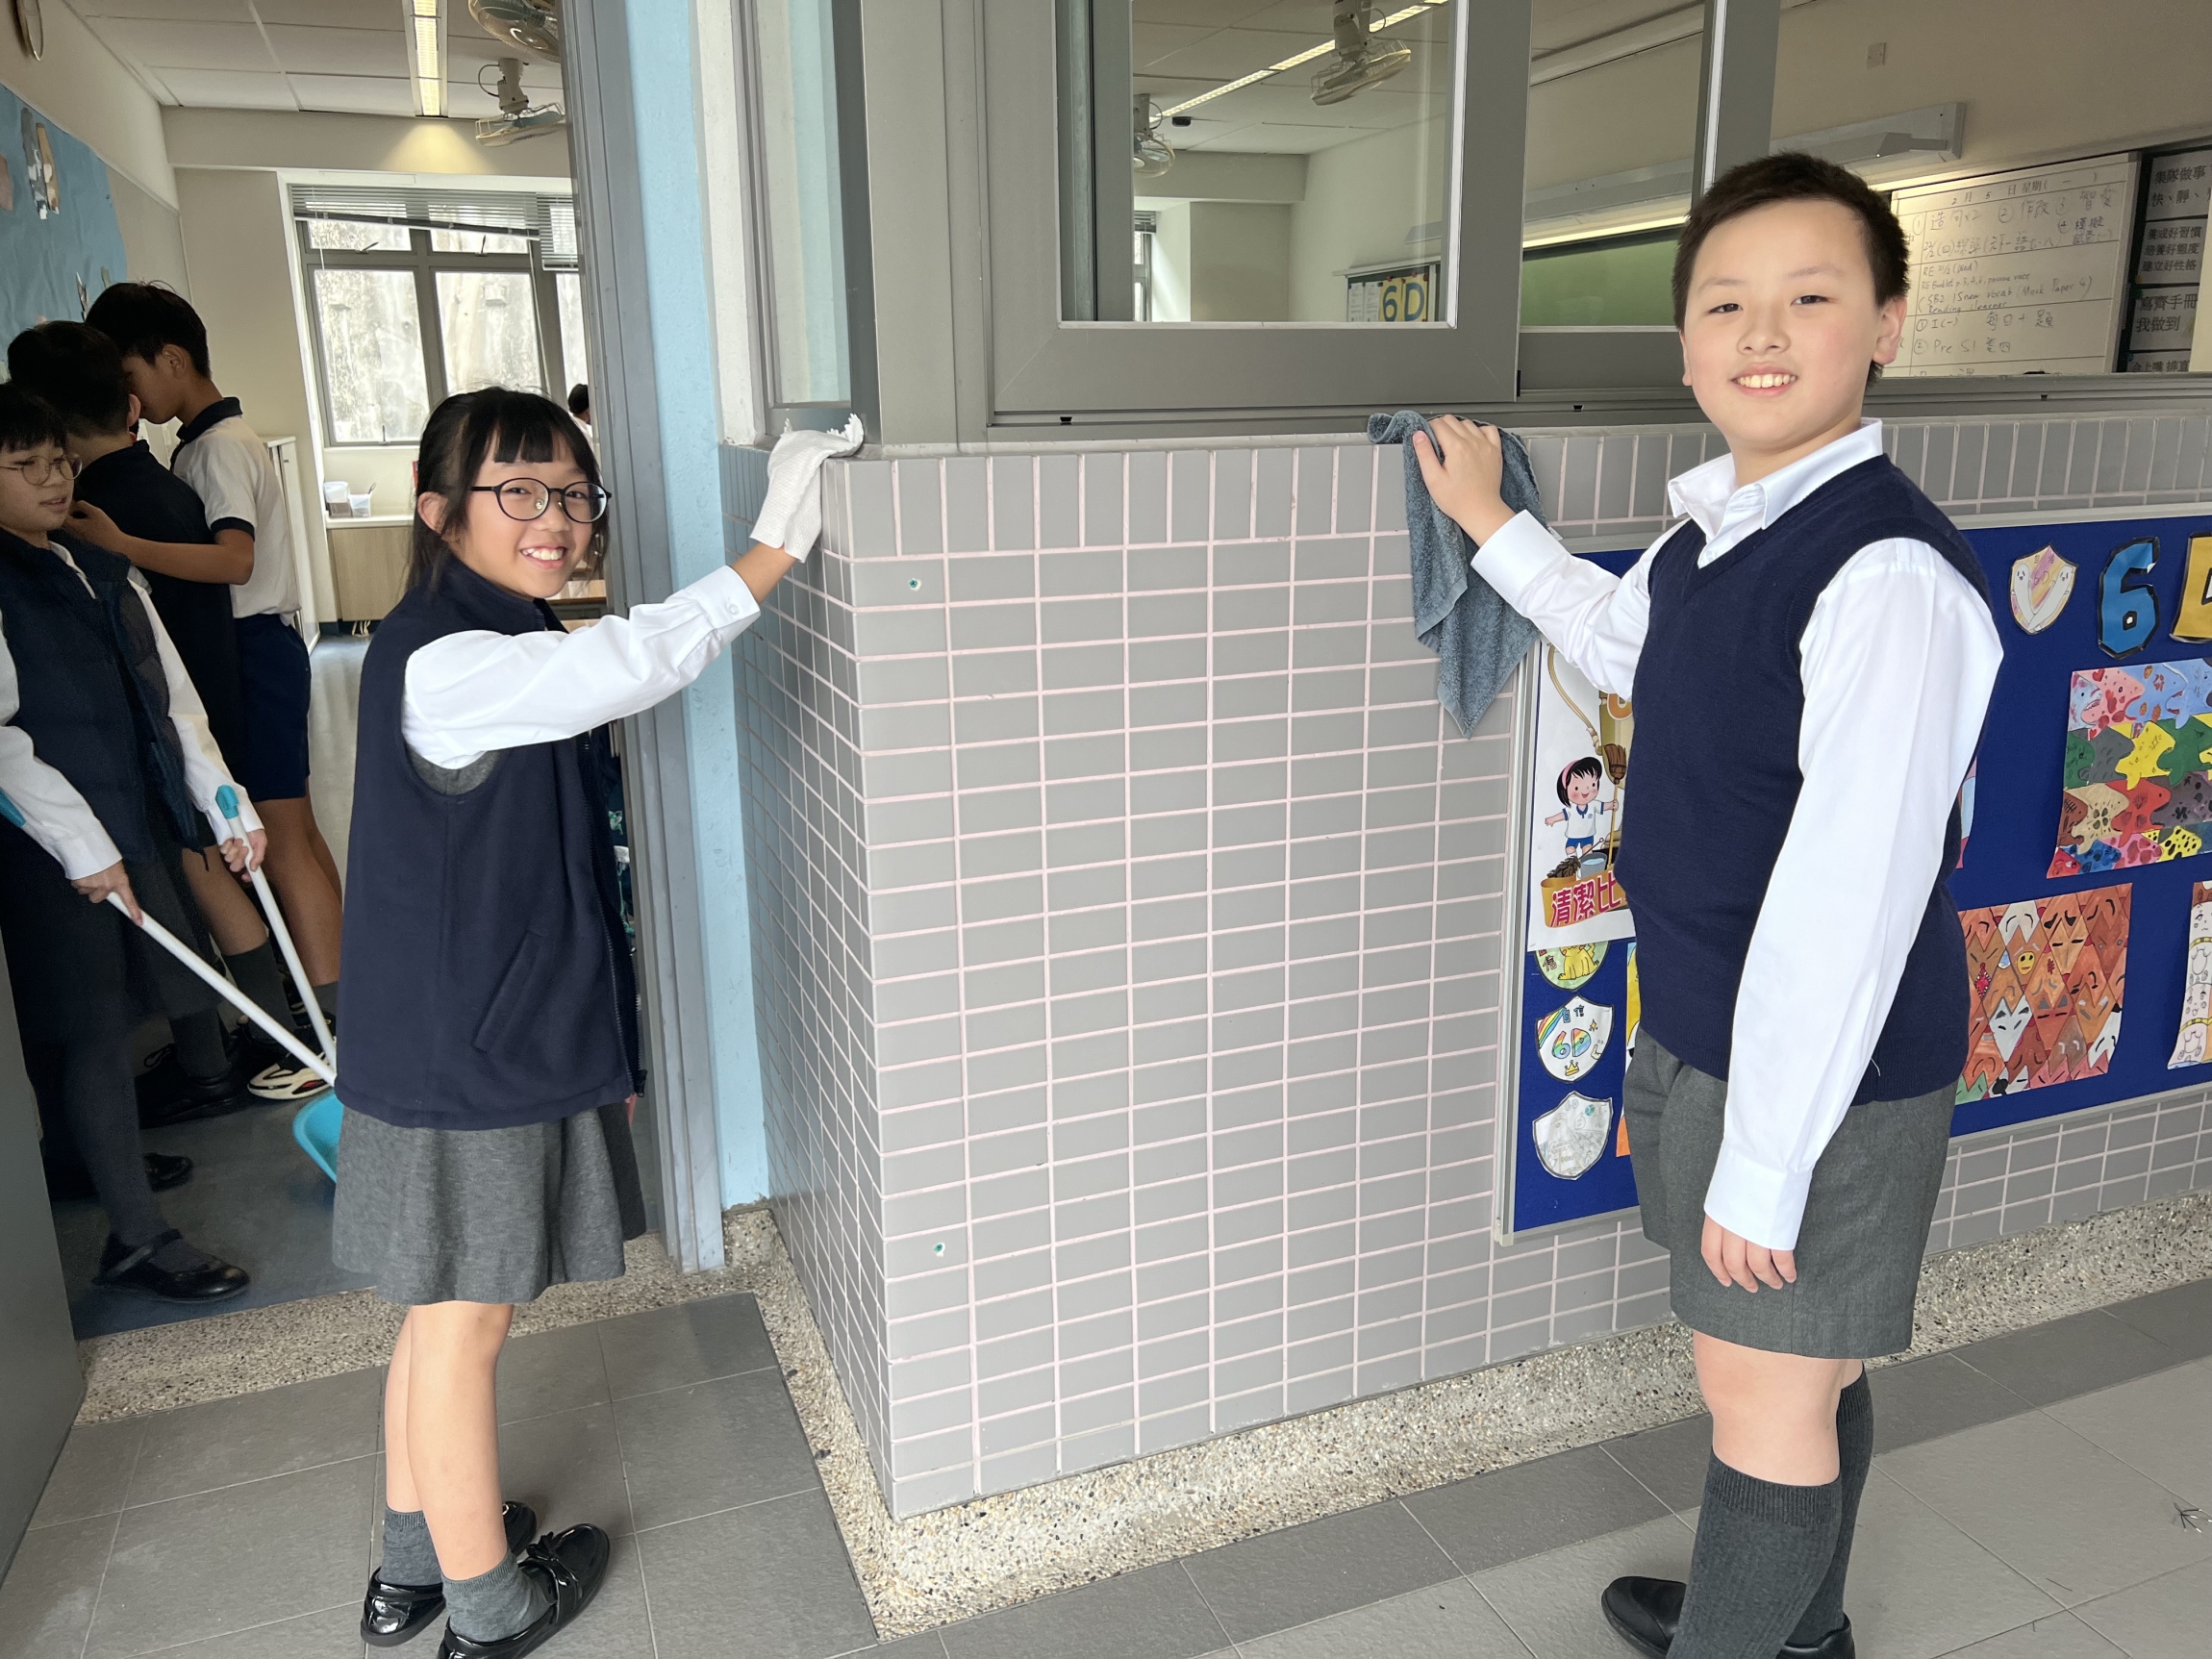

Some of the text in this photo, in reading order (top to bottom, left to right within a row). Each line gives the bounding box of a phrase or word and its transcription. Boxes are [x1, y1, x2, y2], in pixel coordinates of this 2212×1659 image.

[2147, 226, 2203, 240] 養成好習慣
[2141, 259, 2198, 272] 建立好性格
[1382, 282, 1425, 322] 6D
[2135, 315, 2181, 333] 我做到
[1933, 339, 1952, 353] Pre
[1549, 869, 1626, 928] 清潔比
[1551, 1027, 1592, 1059] 6D
